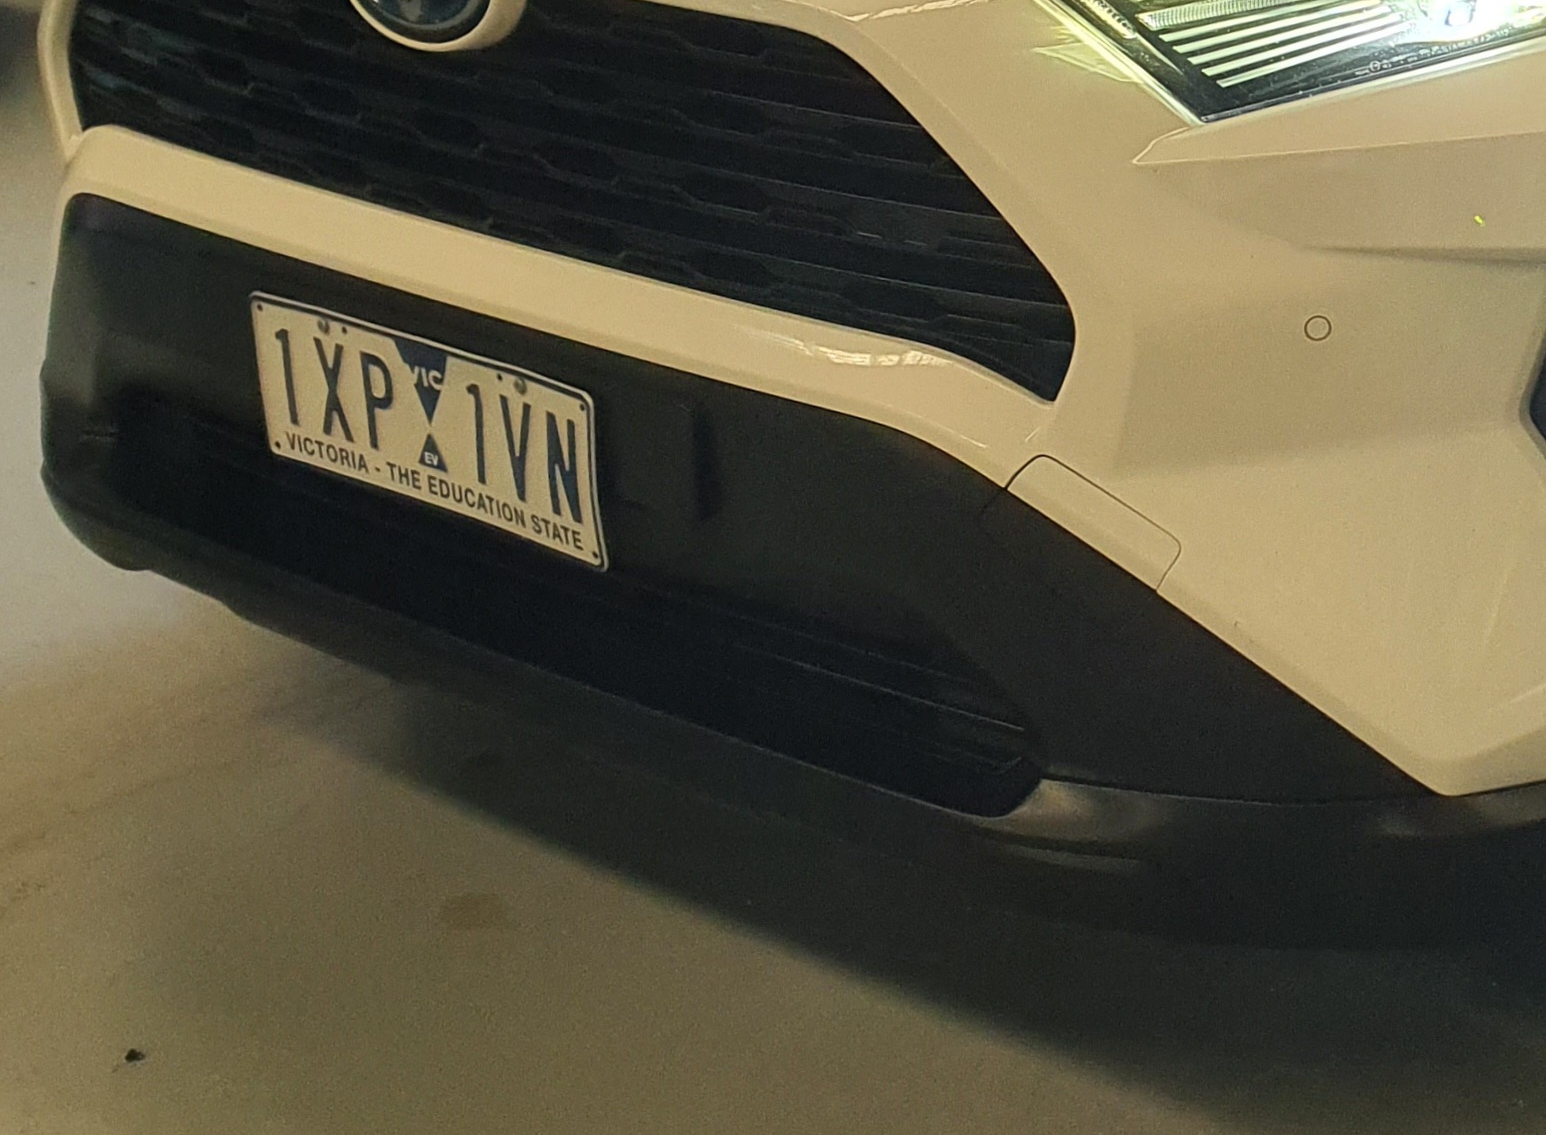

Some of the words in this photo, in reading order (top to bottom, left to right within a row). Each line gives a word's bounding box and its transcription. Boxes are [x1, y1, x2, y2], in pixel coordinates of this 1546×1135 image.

[274, 328, 394, 450] 1XP
[466, 383, 583, 523] 1VN
[423, 451, 439, 467] EV
[285, 431, 369, 474] VICTORIA
[386, 461, 422, 490] THE
[427, 476, 527, 529] EDUCATION
[530, 514, 585, 551] STATE
